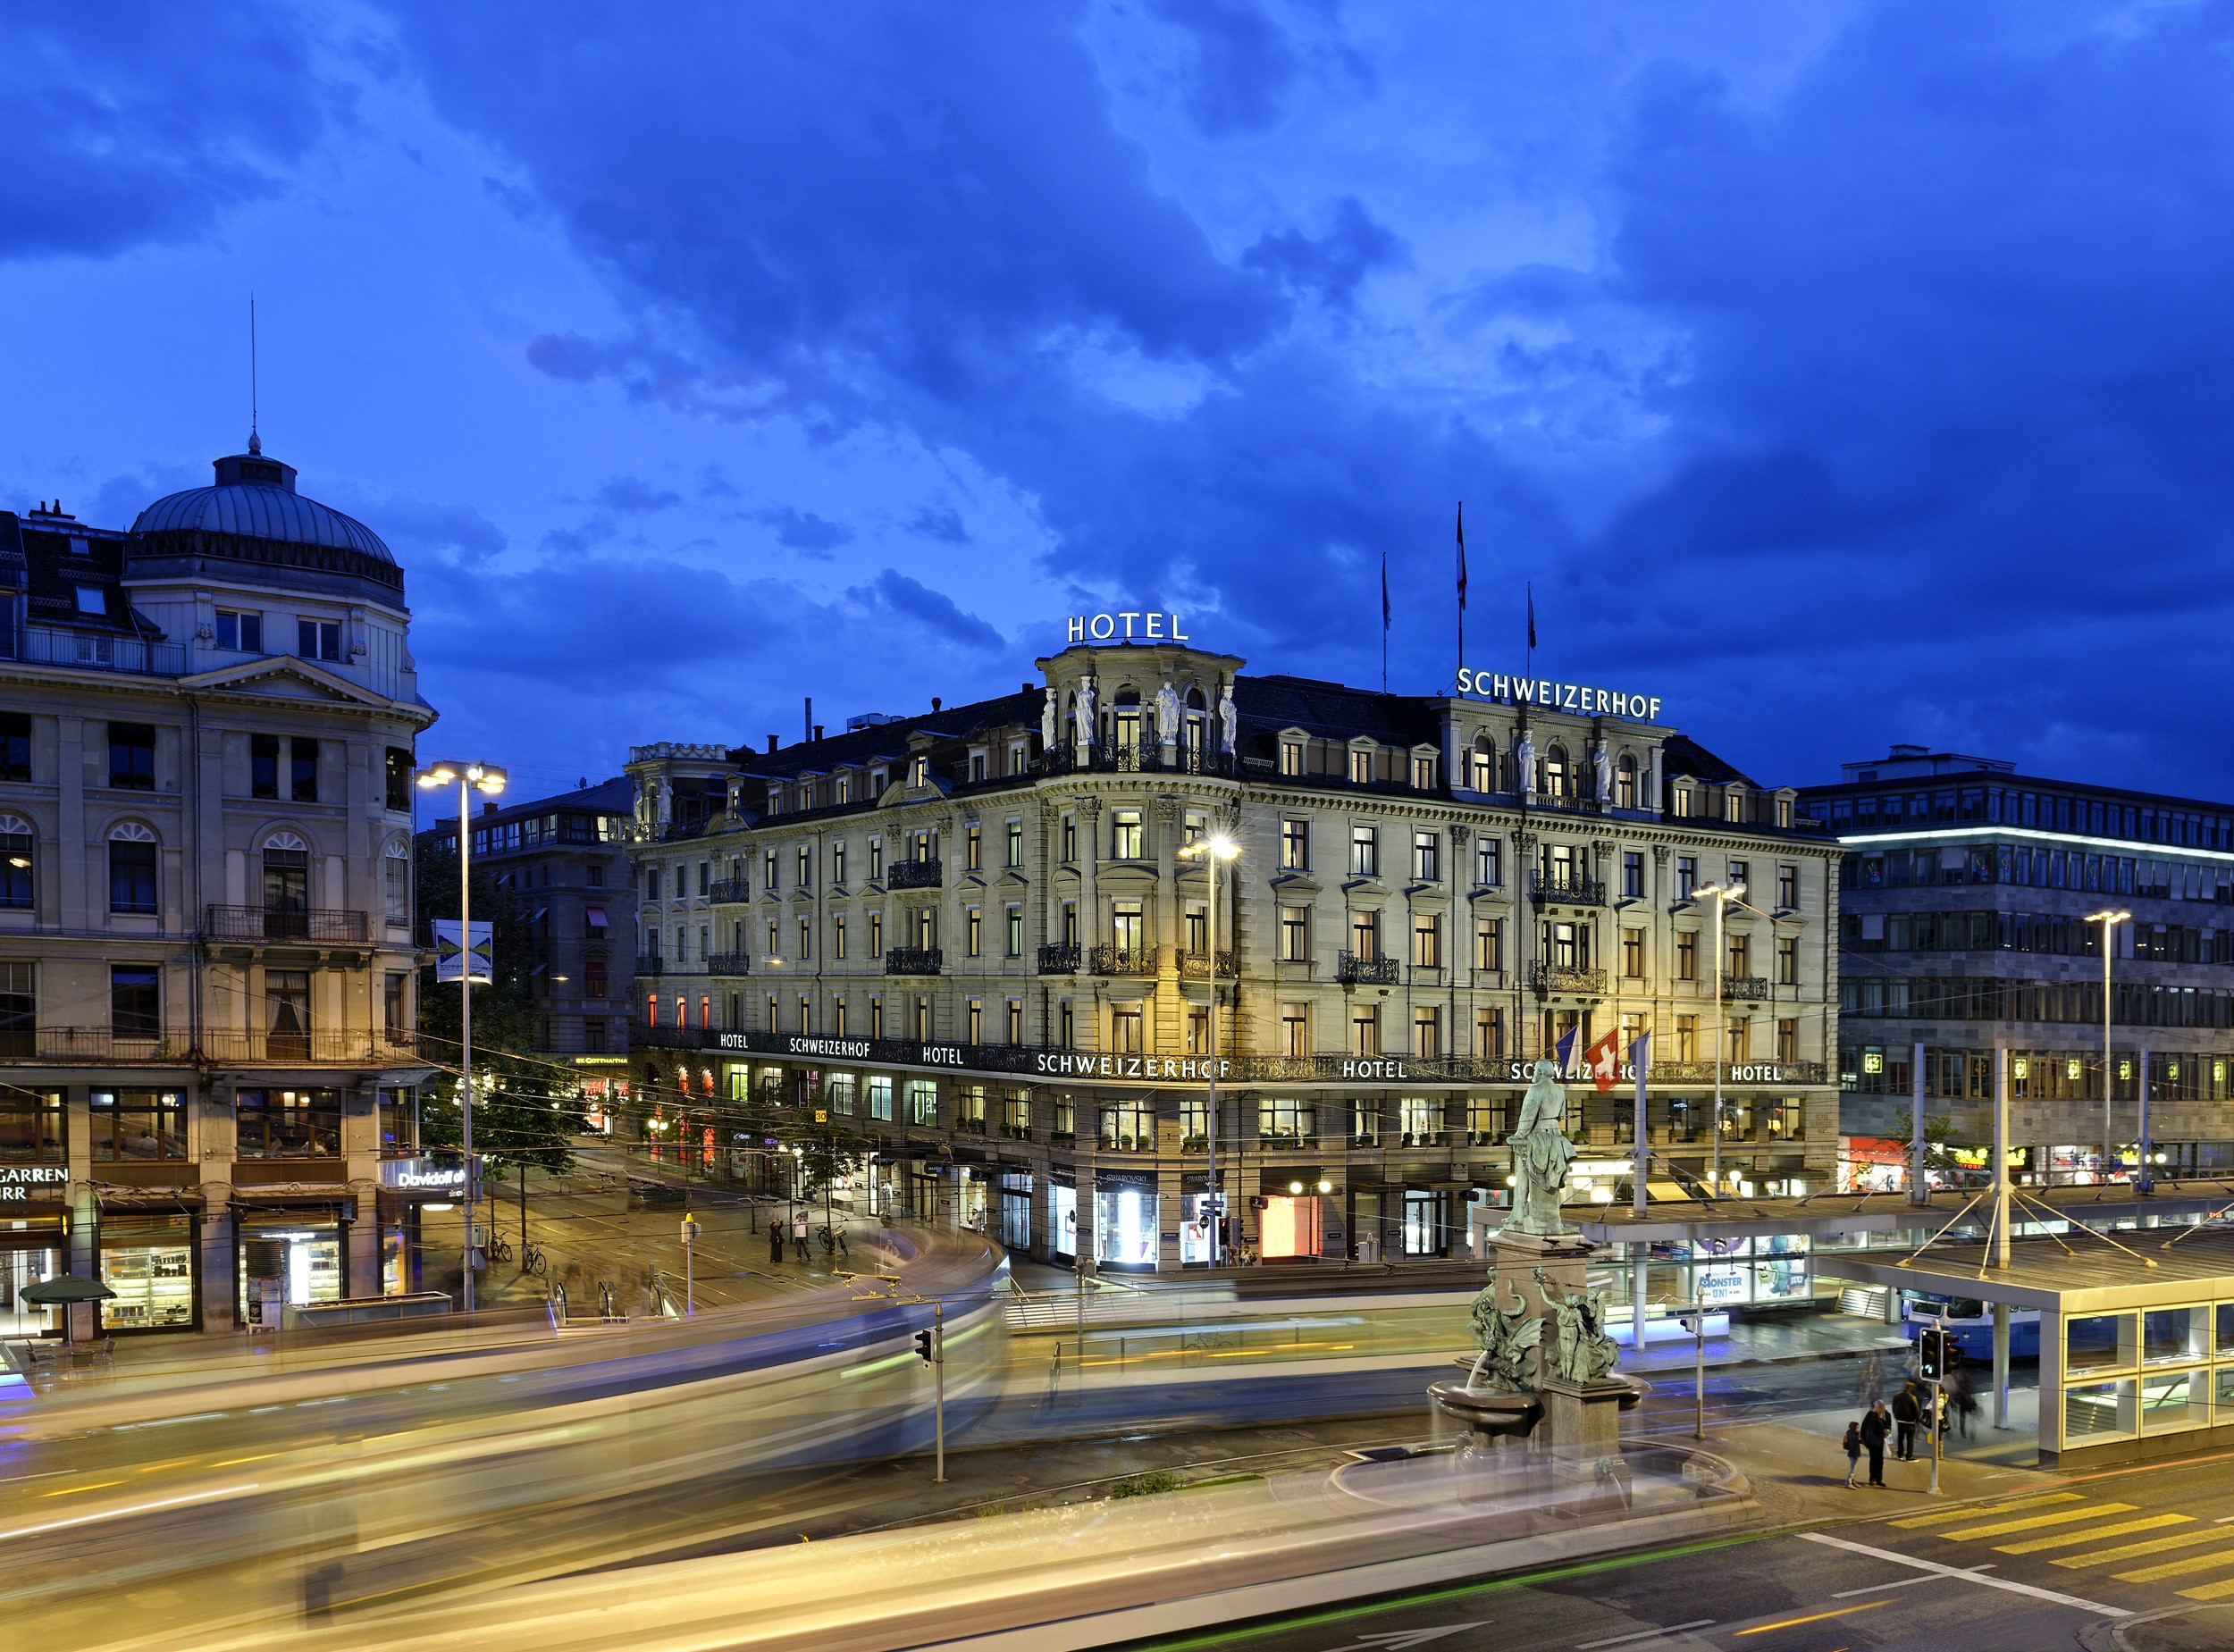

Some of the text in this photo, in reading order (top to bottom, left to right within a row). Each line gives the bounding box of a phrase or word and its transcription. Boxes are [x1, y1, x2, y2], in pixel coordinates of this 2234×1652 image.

[1068, 612, 1189, 642] HOTEL
[1457, 667, 1661, 720] SCHWEIZERHOF
[720, 1034, 749, 1049] HOTEL
[789, 1037, 870, 1058] SCHWEIZERHOF
[923, 1046, 964, 1065] HOTEL
[1037, 1052, 1230, 1078] SCHWEIZERHOF
[1342, 1061, 1408, 1078] HOTEL
[1511, 1062, 1648, 1081] SCWIZHO
[1732, 1065, 1782, 1081] HOTEL
[399, 1170, 453, 1187] Davidoff
[1106, 1173, 1146, 1183] SWAROVSKI
[1187, 1175, 1209, 1184] SWAROV
[0, 1187, 26, 1200] RR
[1700, 1277, 1743, 1287] MONSTER
